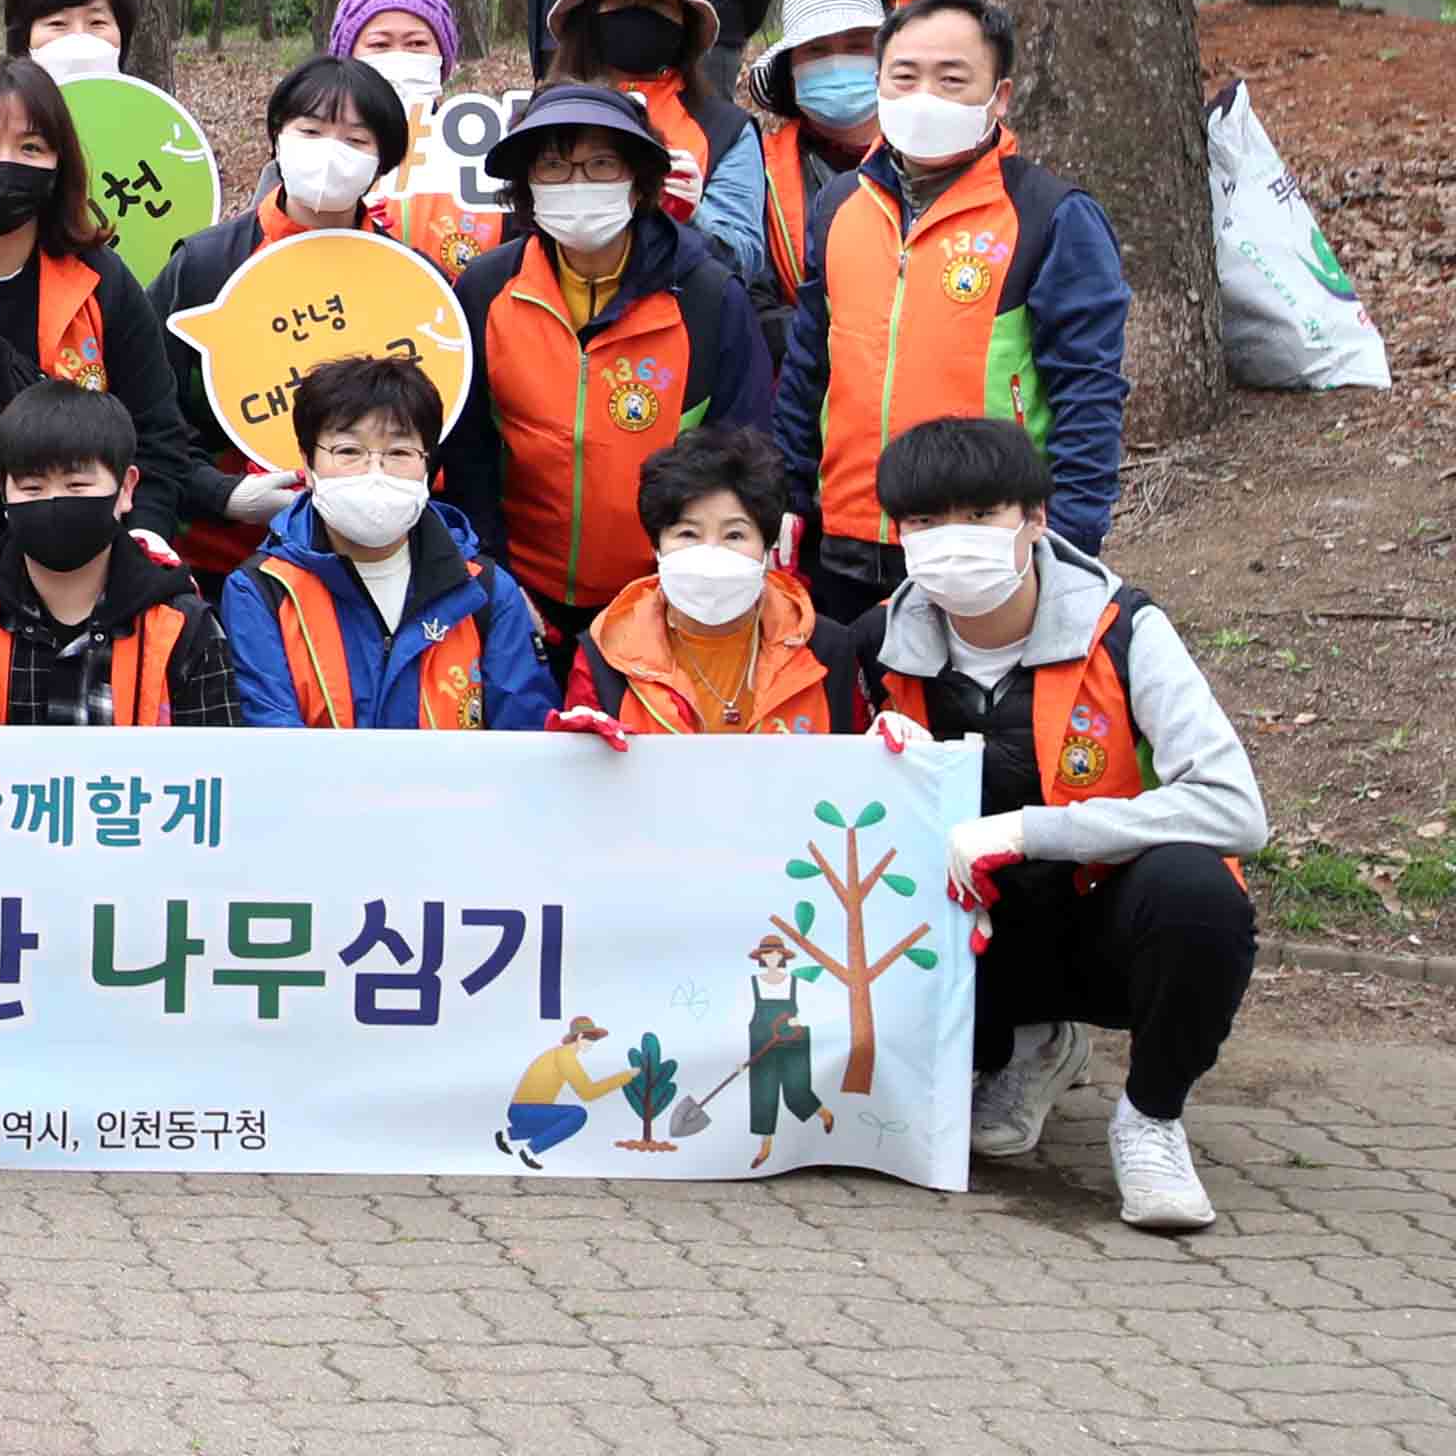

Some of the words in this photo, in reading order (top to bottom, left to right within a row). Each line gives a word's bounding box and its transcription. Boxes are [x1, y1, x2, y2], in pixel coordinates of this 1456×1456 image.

[937, 230, 1009, 263] 1365
[271, 294, 347, 342] 안녕
[599, 356, 673, 392] 1365
[91, 897, 564, 1027] 나무심기
[95, 1109, 268, 1152] 인천동구청
